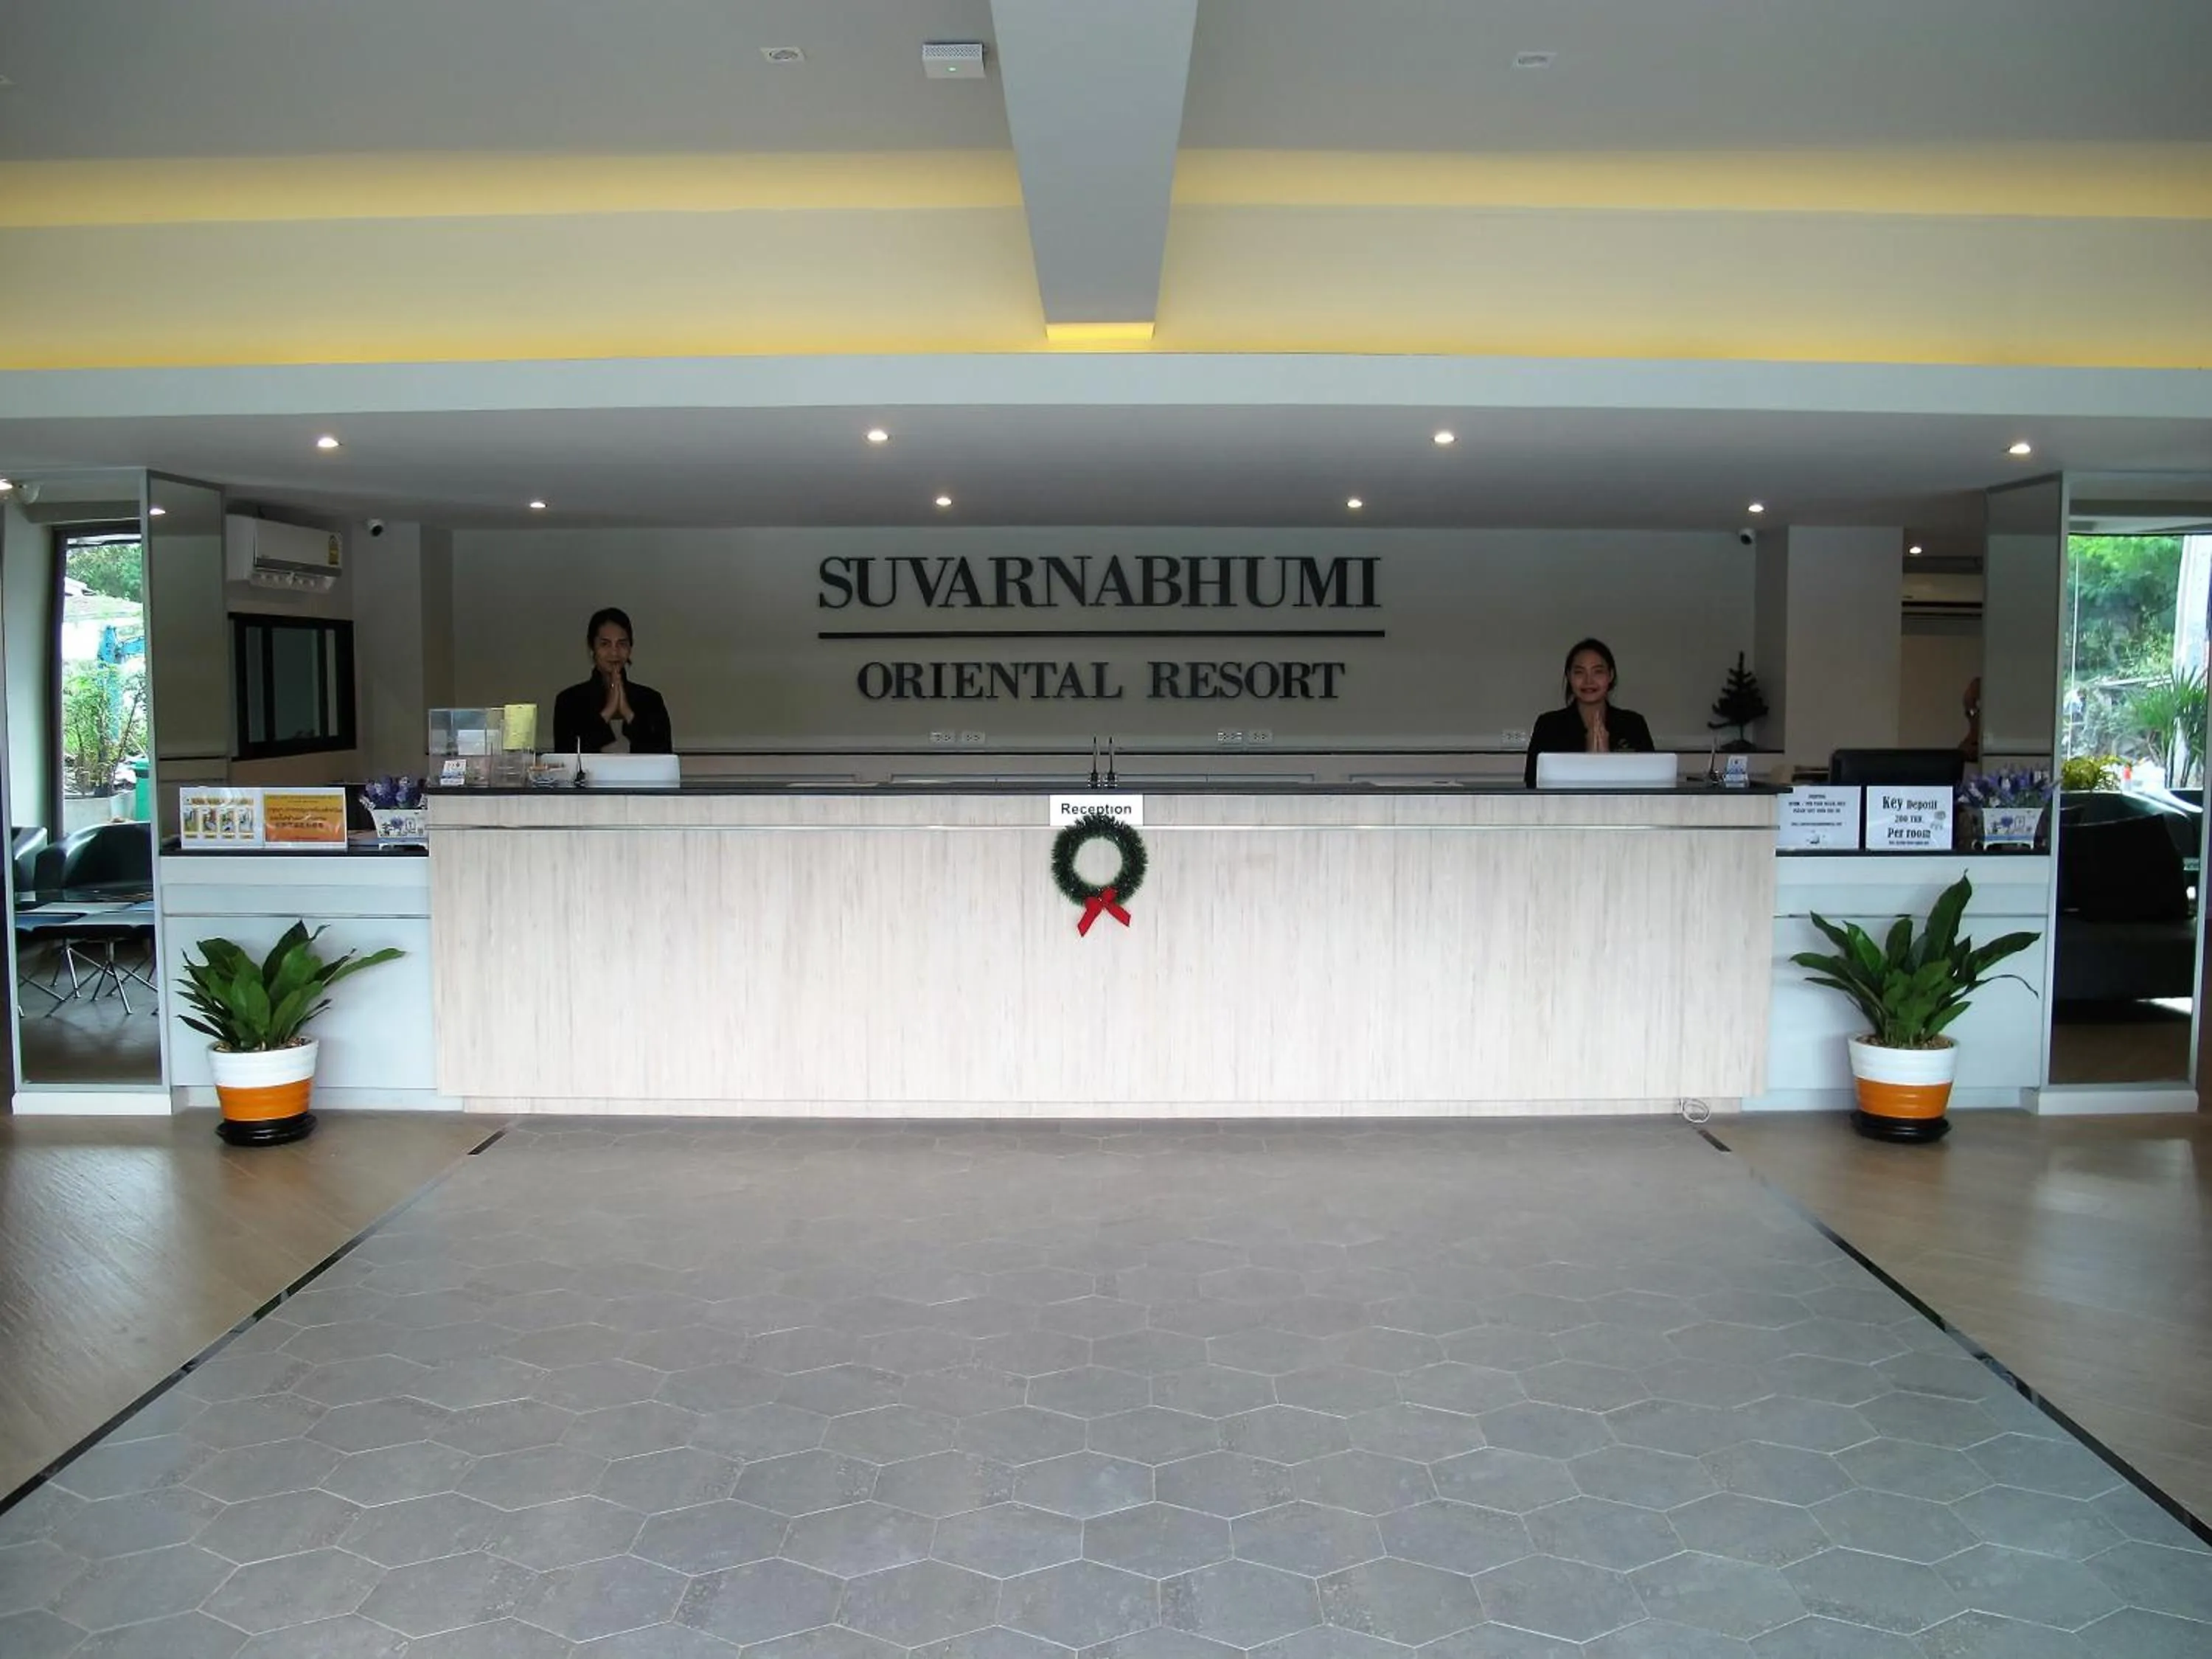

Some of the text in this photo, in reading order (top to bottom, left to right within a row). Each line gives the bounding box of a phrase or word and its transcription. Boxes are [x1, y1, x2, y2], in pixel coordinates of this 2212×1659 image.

[818, 554, 1382, 610] SUVARNABHUMI
[856, 661, 1346, 700] ORIENTAL RESORT
[1061, 803, 1132, 815] Reception
[1882, 796, 1903, 811] Key
[1888, 827, 1931, 838] Per room
